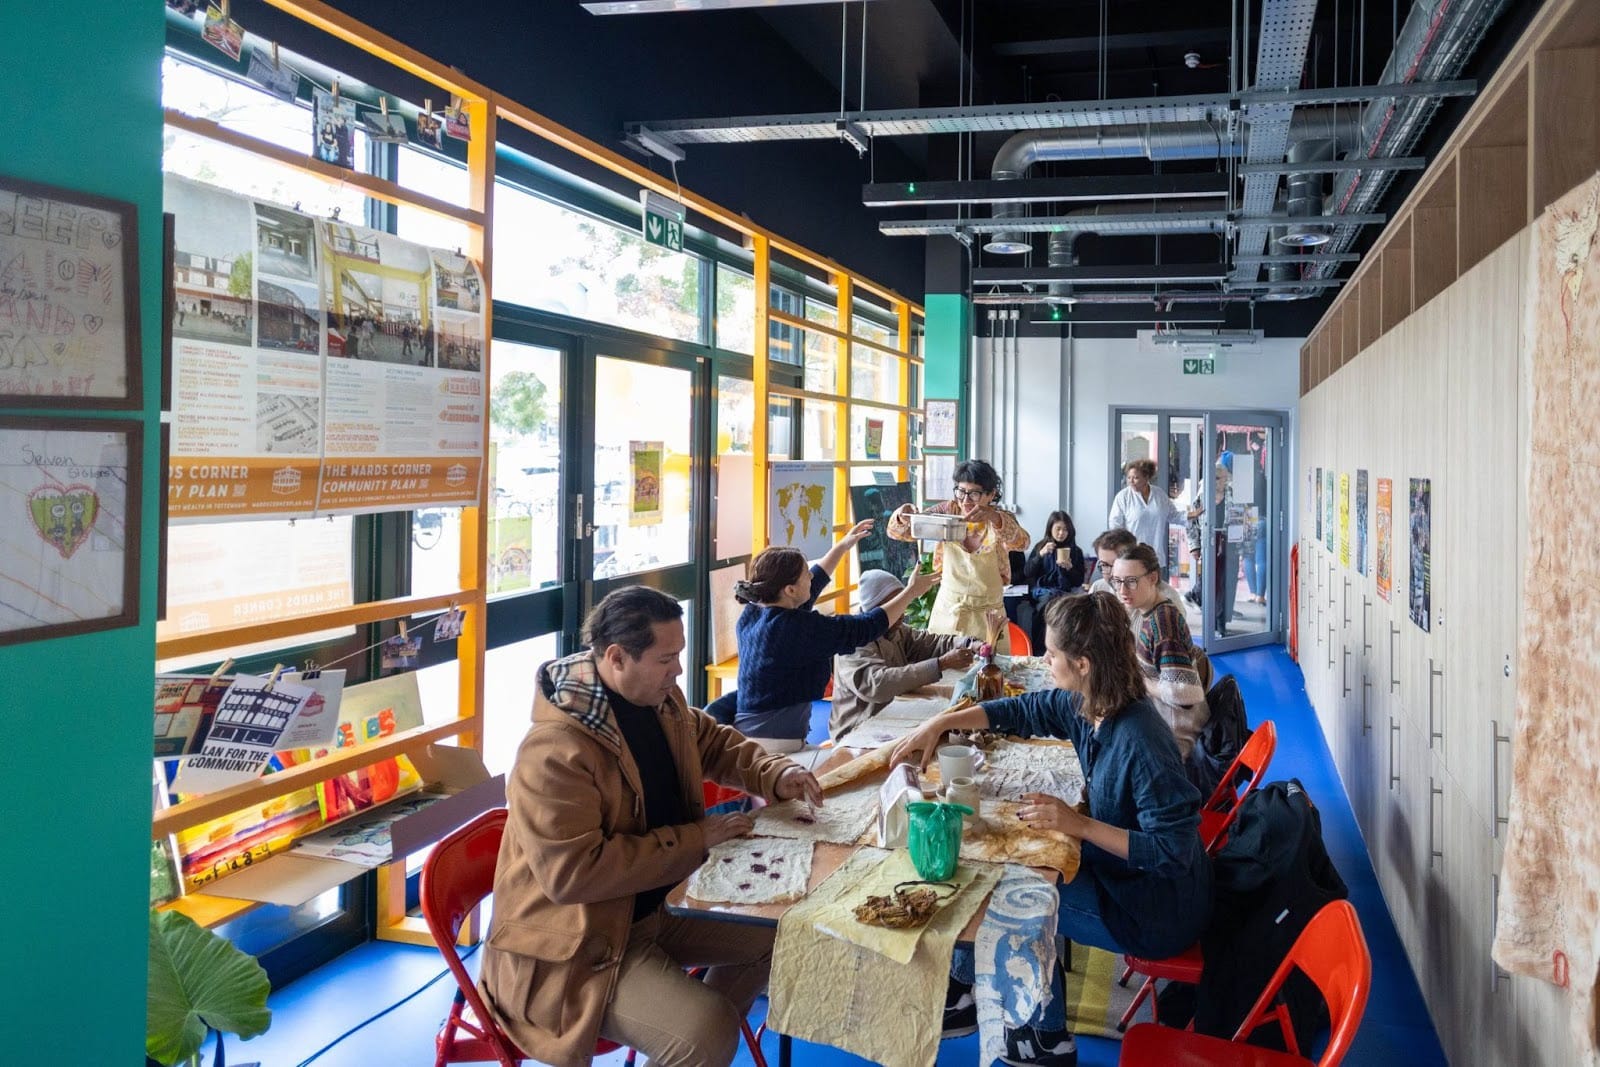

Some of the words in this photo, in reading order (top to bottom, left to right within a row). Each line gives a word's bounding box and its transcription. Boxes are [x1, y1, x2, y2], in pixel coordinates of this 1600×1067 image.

[189, 465, 248, 479] CORNER
[326, 465, 347, 477] THE
[350, 464, 388, 477] WARDS
[391, 463, 432, 475] CORNER
[189, 484, 228, 498] PLAN
[322, 480, 387, 493] COMMUNITY
[390, 479, 417, 490] PLAN
[225, 748, 247, 759] FOR
[248, 750, 269, 762] THE
[187, 757, 264, 773] COMMUNITY
[1016, 1039, 1036, 1060] N
